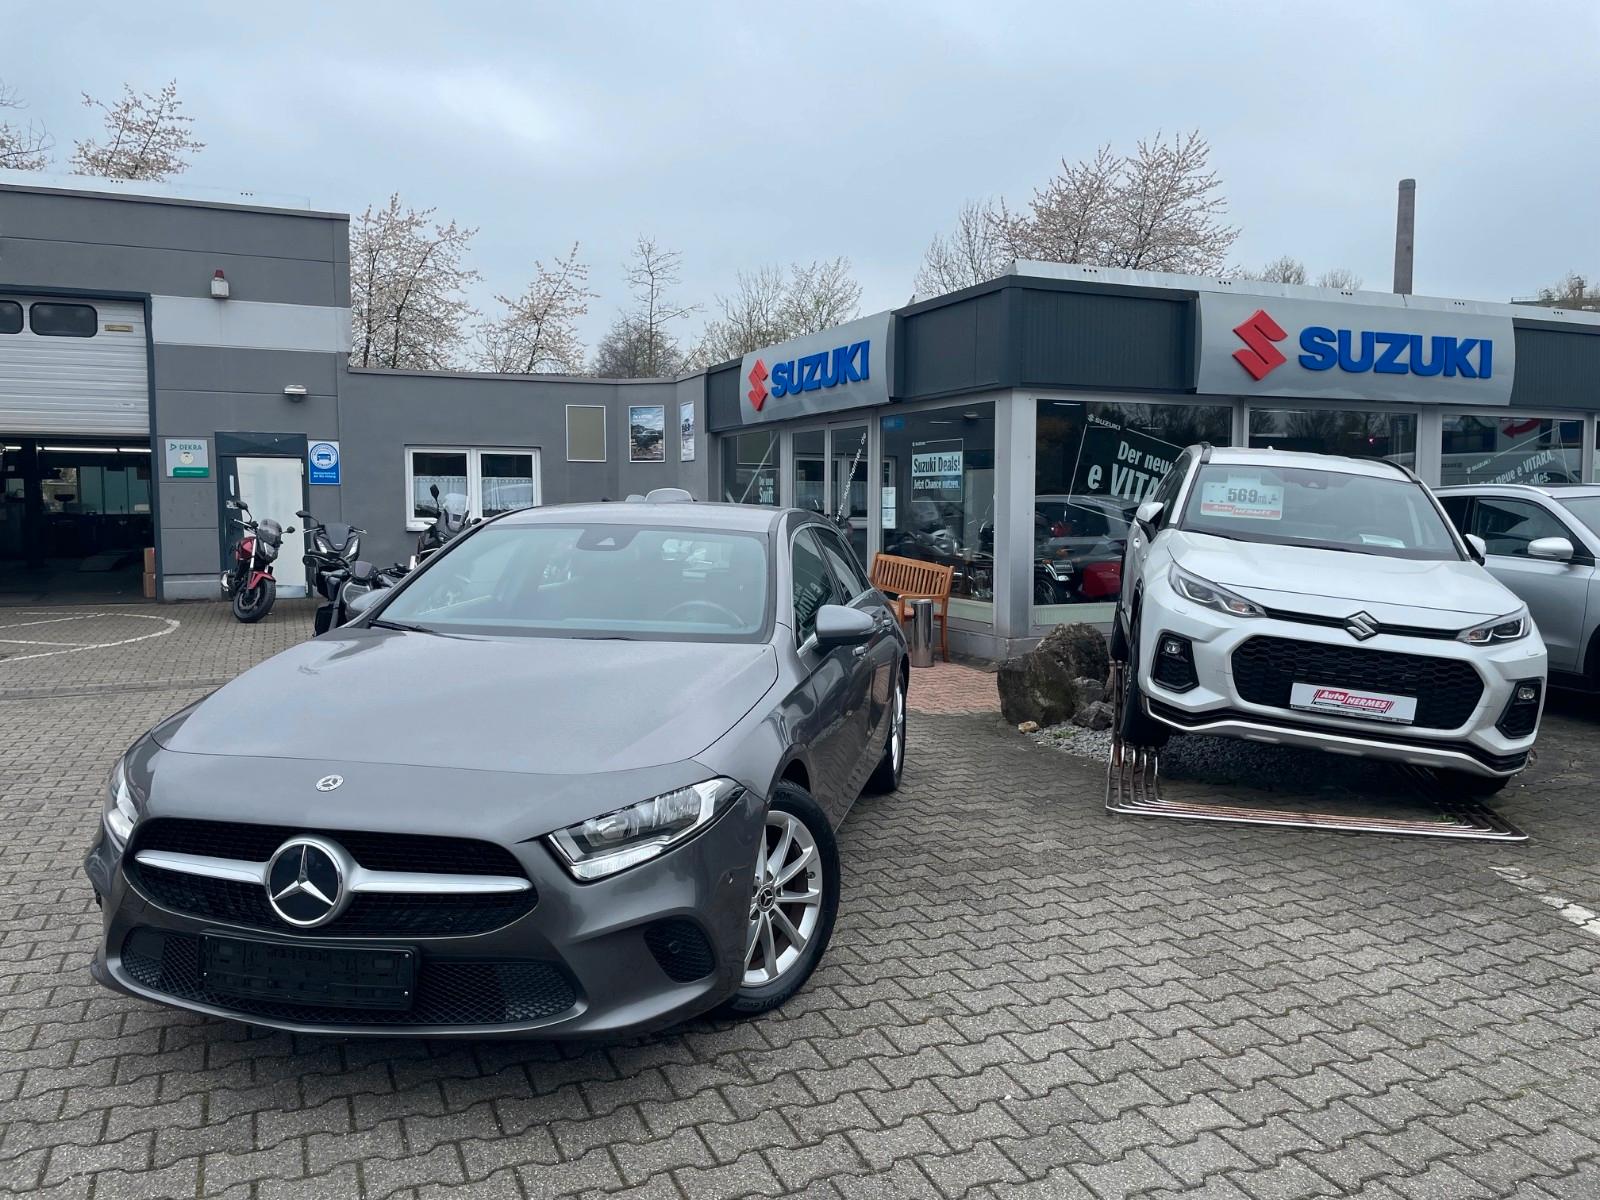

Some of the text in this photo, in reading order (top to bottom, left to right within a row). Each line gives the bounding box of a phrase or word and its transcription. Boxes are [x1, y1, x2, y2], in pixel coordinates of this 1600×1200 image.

[1298, 325, 1493, 379] SUZUKI
[771, 340, 870, 398] SUZUKI
[1095, 417, 1121, 430] SUZUKI
[1117, 440, 1143, 465] Der
[1517, 466, 1522, 477] e
[1522, 450, 1555, 473] VITARA.
[913, 455, 960, 473] Suzuki Deals!
[1087, 464, 1103, 490] e
[759, 486, 773, 503] Swift
[1227, 488, 1258, 503] 569
[1320, 690, 1345, 701] Auto
[1346, 696, 1389, 709] HERMES
